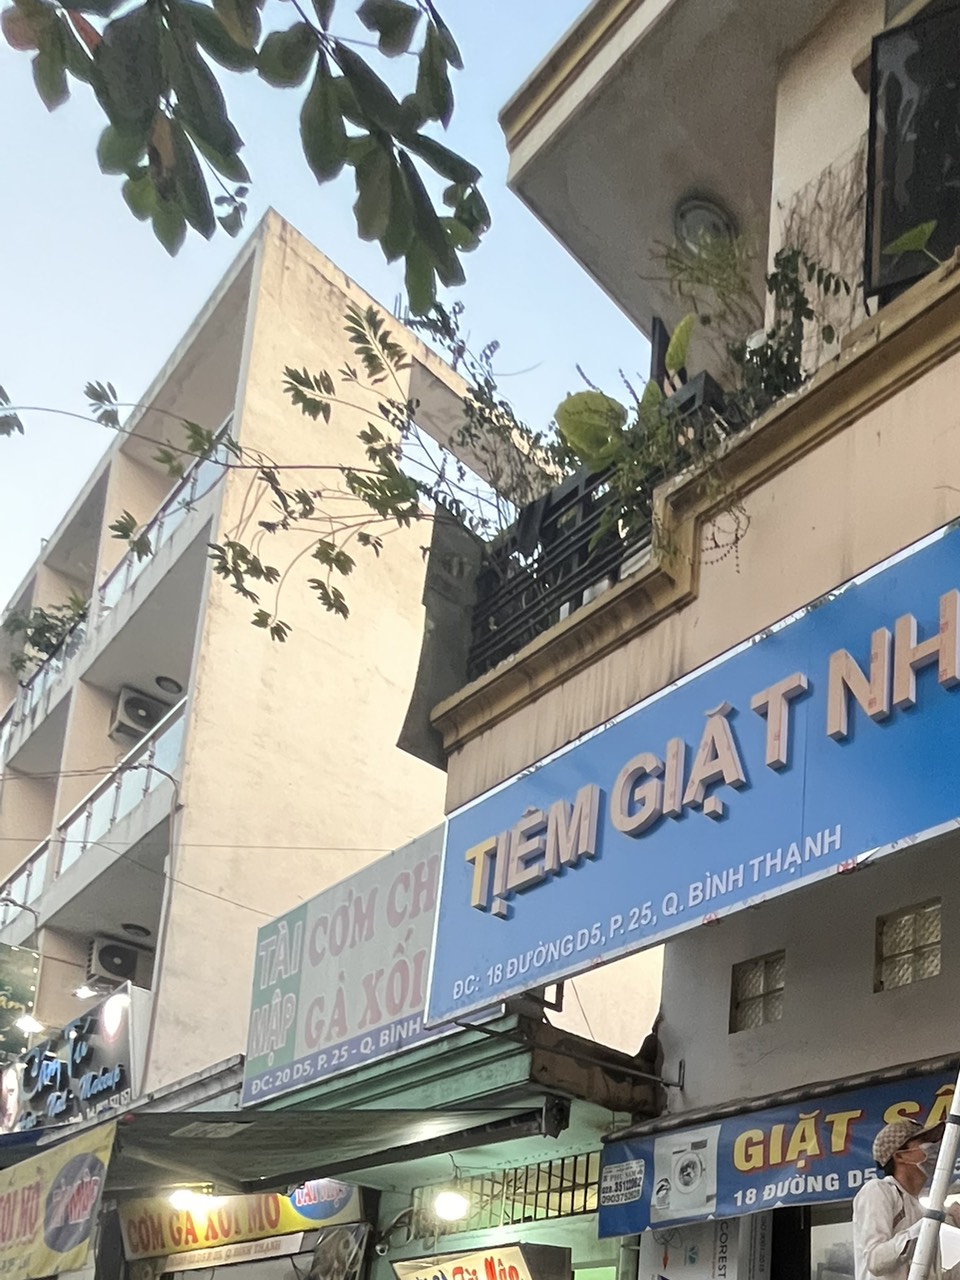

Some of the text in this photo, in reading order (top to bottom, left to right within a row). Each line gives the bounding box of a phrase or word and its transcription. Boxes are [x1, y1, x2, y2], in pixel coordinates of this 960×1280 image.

[611, 671, 811, 837] GIẶT
[259, 920, 304, 990] TÀI
[308, 885, 379, 968] CƠM
[452, 824, 843, 1000] ĐC: 18 ĐƯỜNG D5, P. 25, Q. BÌNH THẠNH
[248, 988, 297, 1066] MẬP
[358, 926, 427, 1030] XỐI
[251, 1073, 273, 1095] ĐC:
[275, 1068, 291, 1086] 20
[293, 1061, 314, 1078] D5,
[317, 1055, 329, 1071] P.
[331, 1046, 348, 1064] 25
[360, 1037, 376, 1055] Q.
[379, 1015, 422, 1049] BÌNH
[733, 1108, 863, 1173] GIẶT
[734, 1188, 757, 1207] 18
[762, 1170, 839, 1200] ĐƯỜNG
